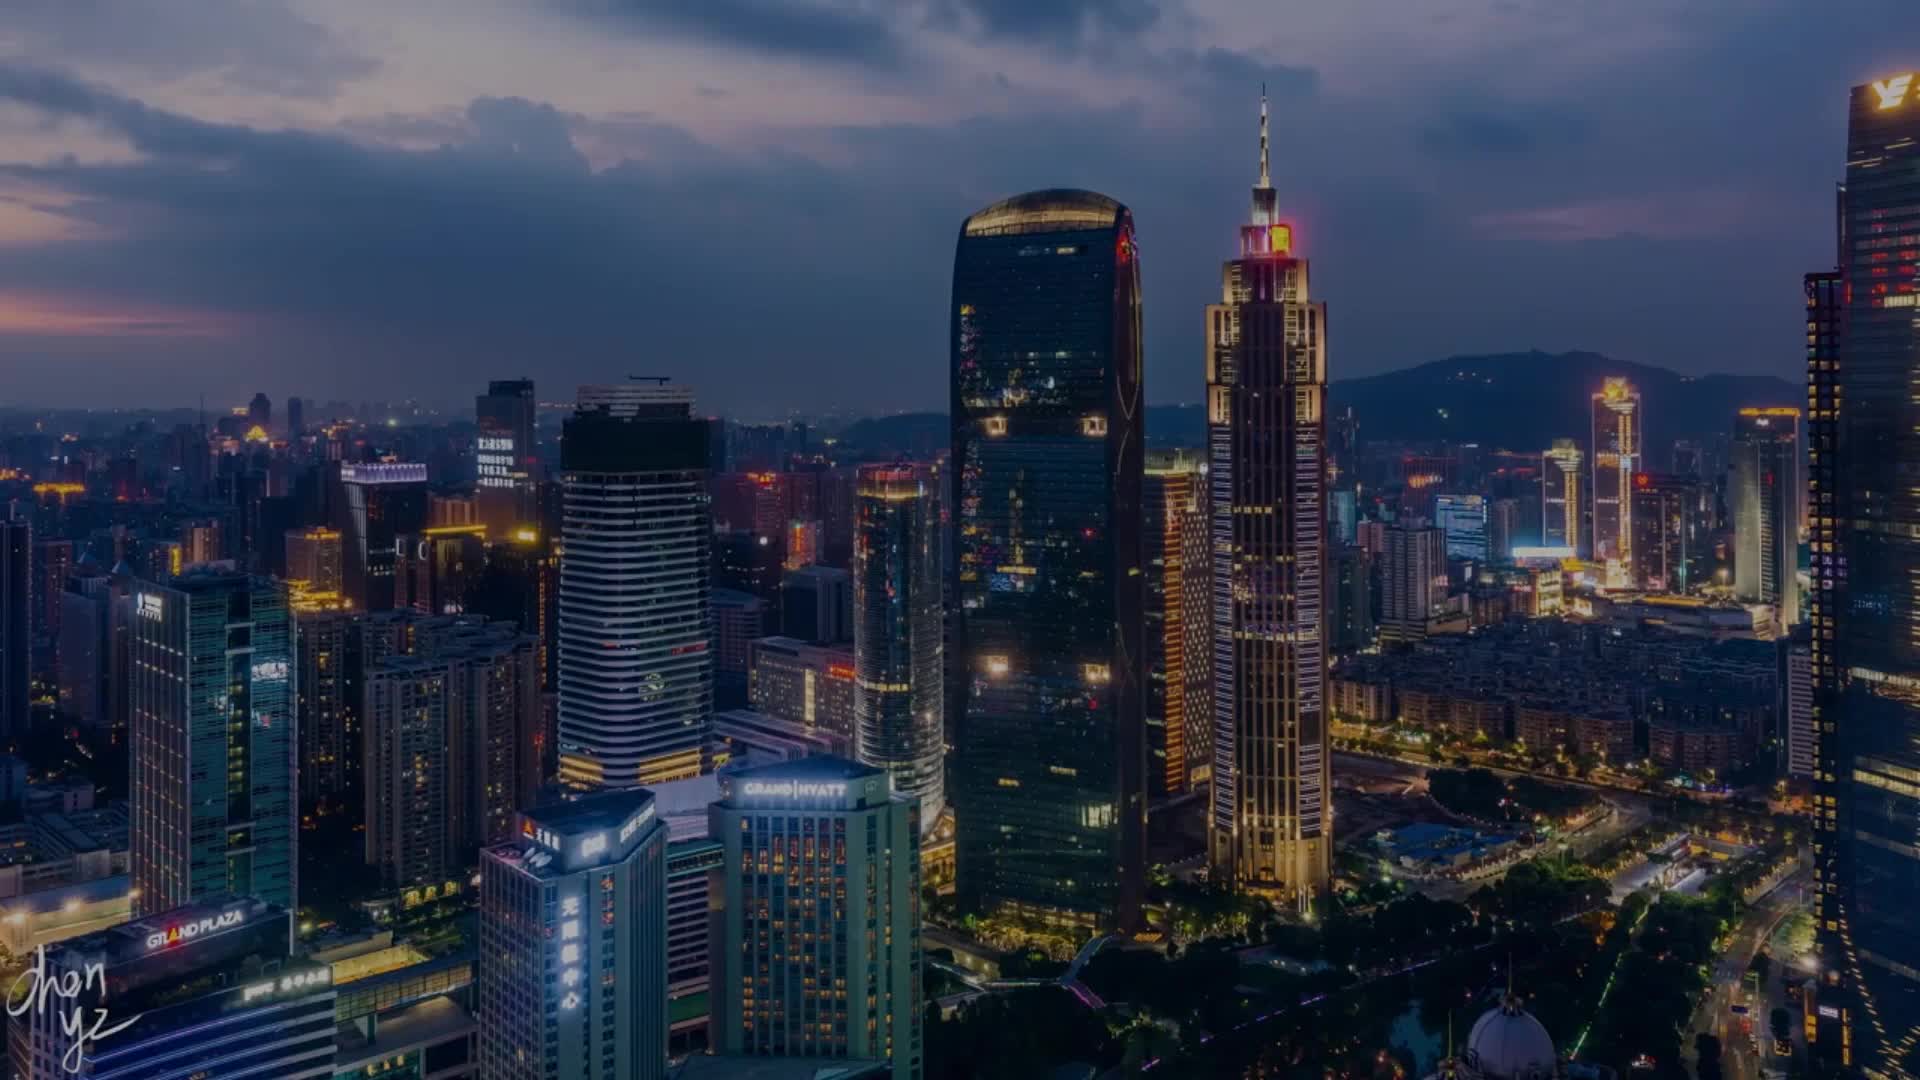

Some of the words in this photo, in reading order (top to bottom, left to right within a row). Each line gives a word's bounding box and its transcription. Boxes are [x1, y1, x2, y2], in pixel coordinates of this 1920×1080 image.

[743, 782, 794, 796] GRAND
[799, 783, 847, 797] HYATT
[200, 910, 243, 933] PLAZA
